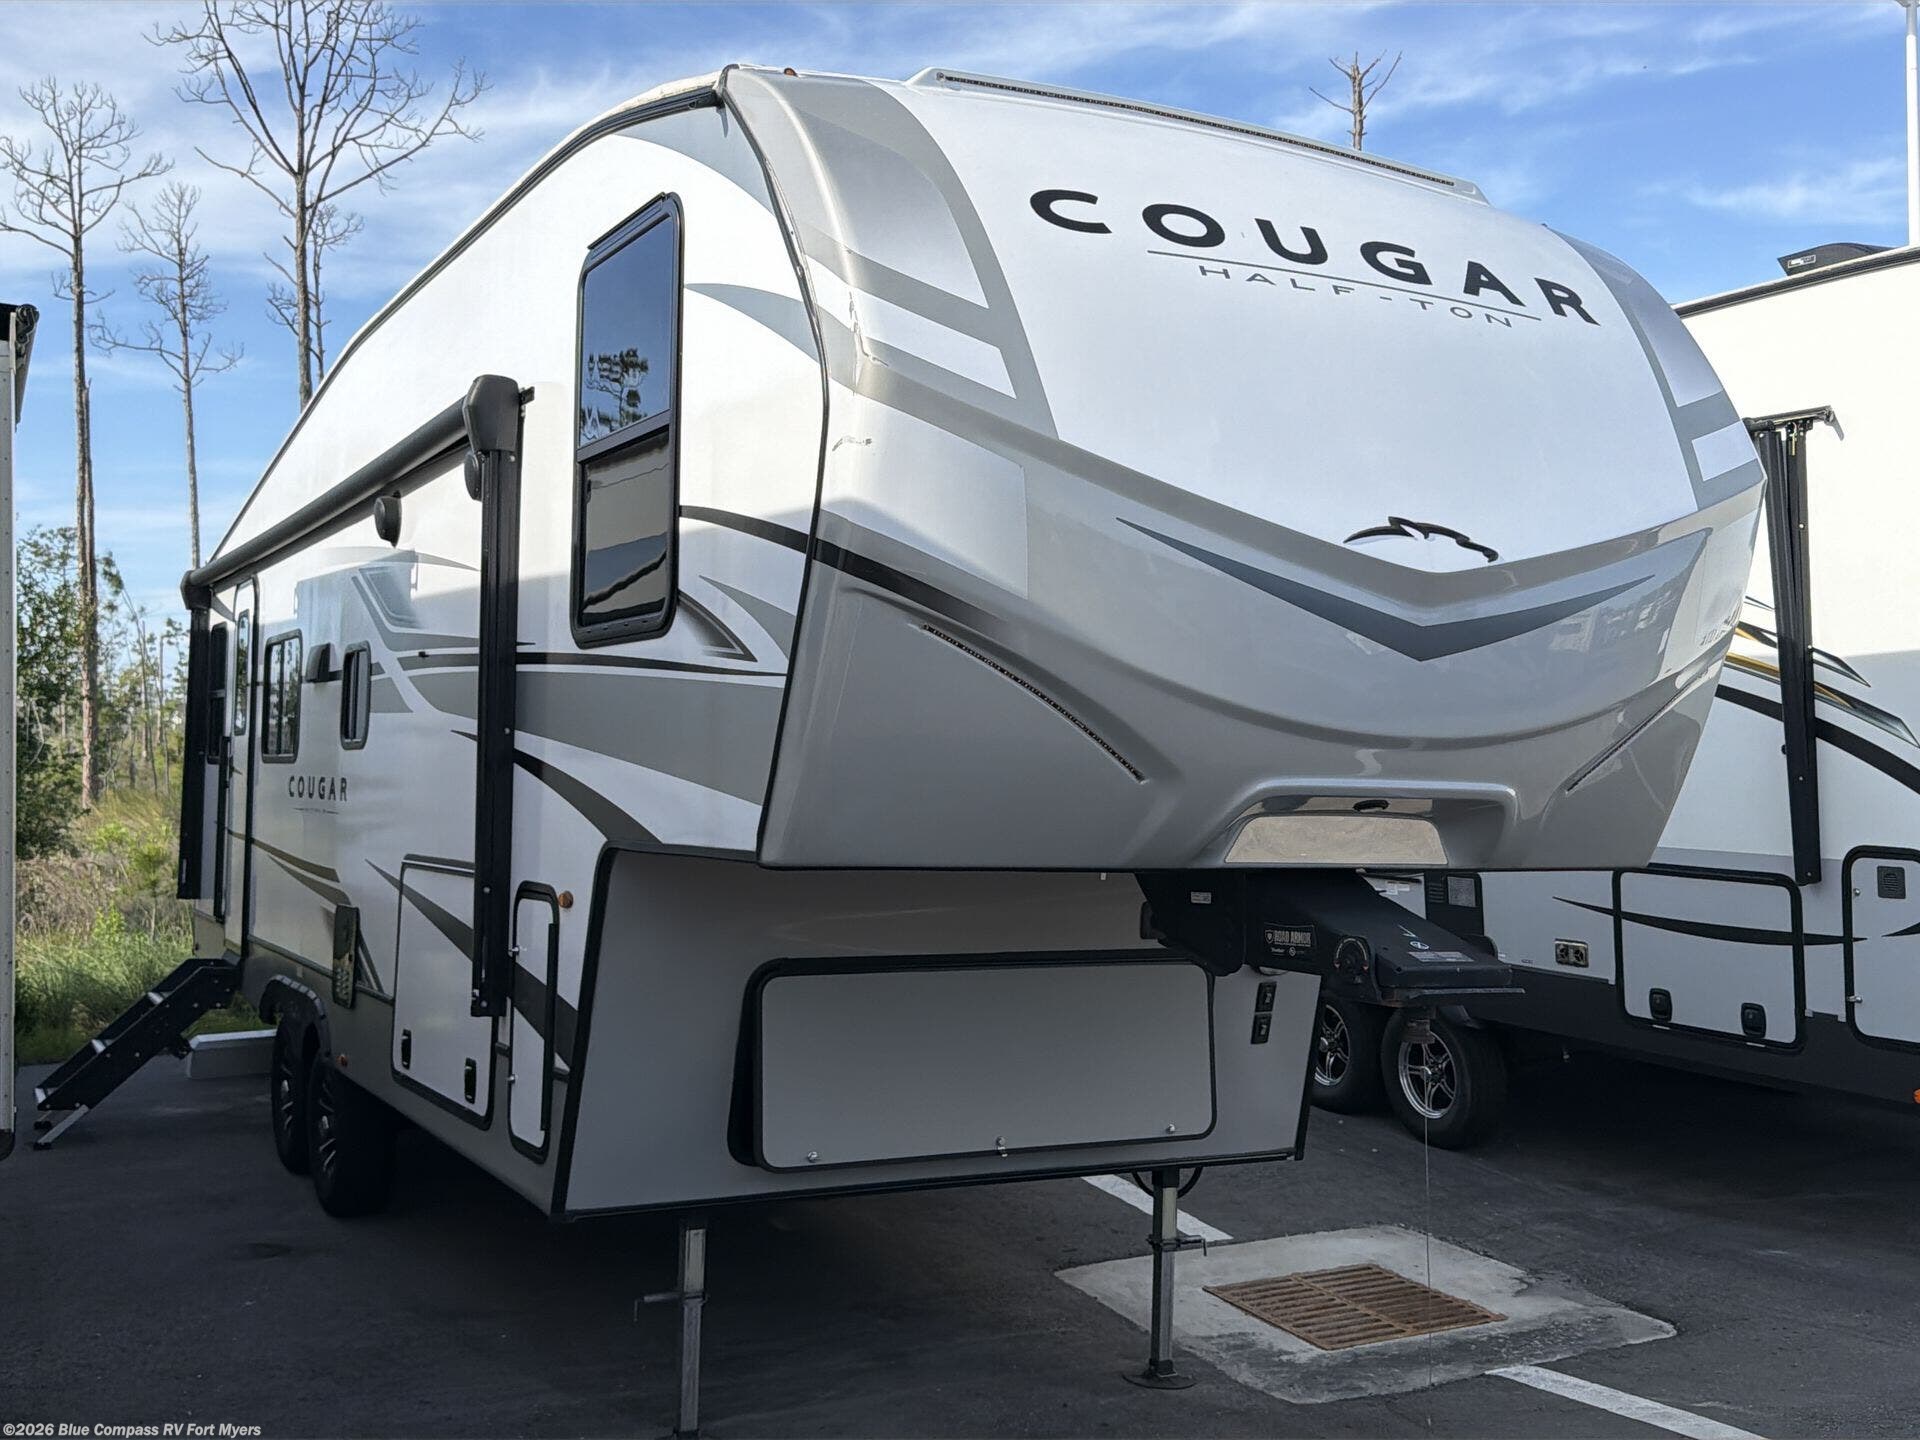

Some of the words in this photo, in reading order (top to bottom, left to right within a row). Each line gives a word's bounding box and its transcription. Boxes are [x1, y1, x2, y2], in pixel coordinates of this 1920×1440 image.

[1029, 188, 1601, 327] COUGAR
[1199, 264, 1513, 329] HALF-TON
[288, 775, 348, 802] COUGAR
